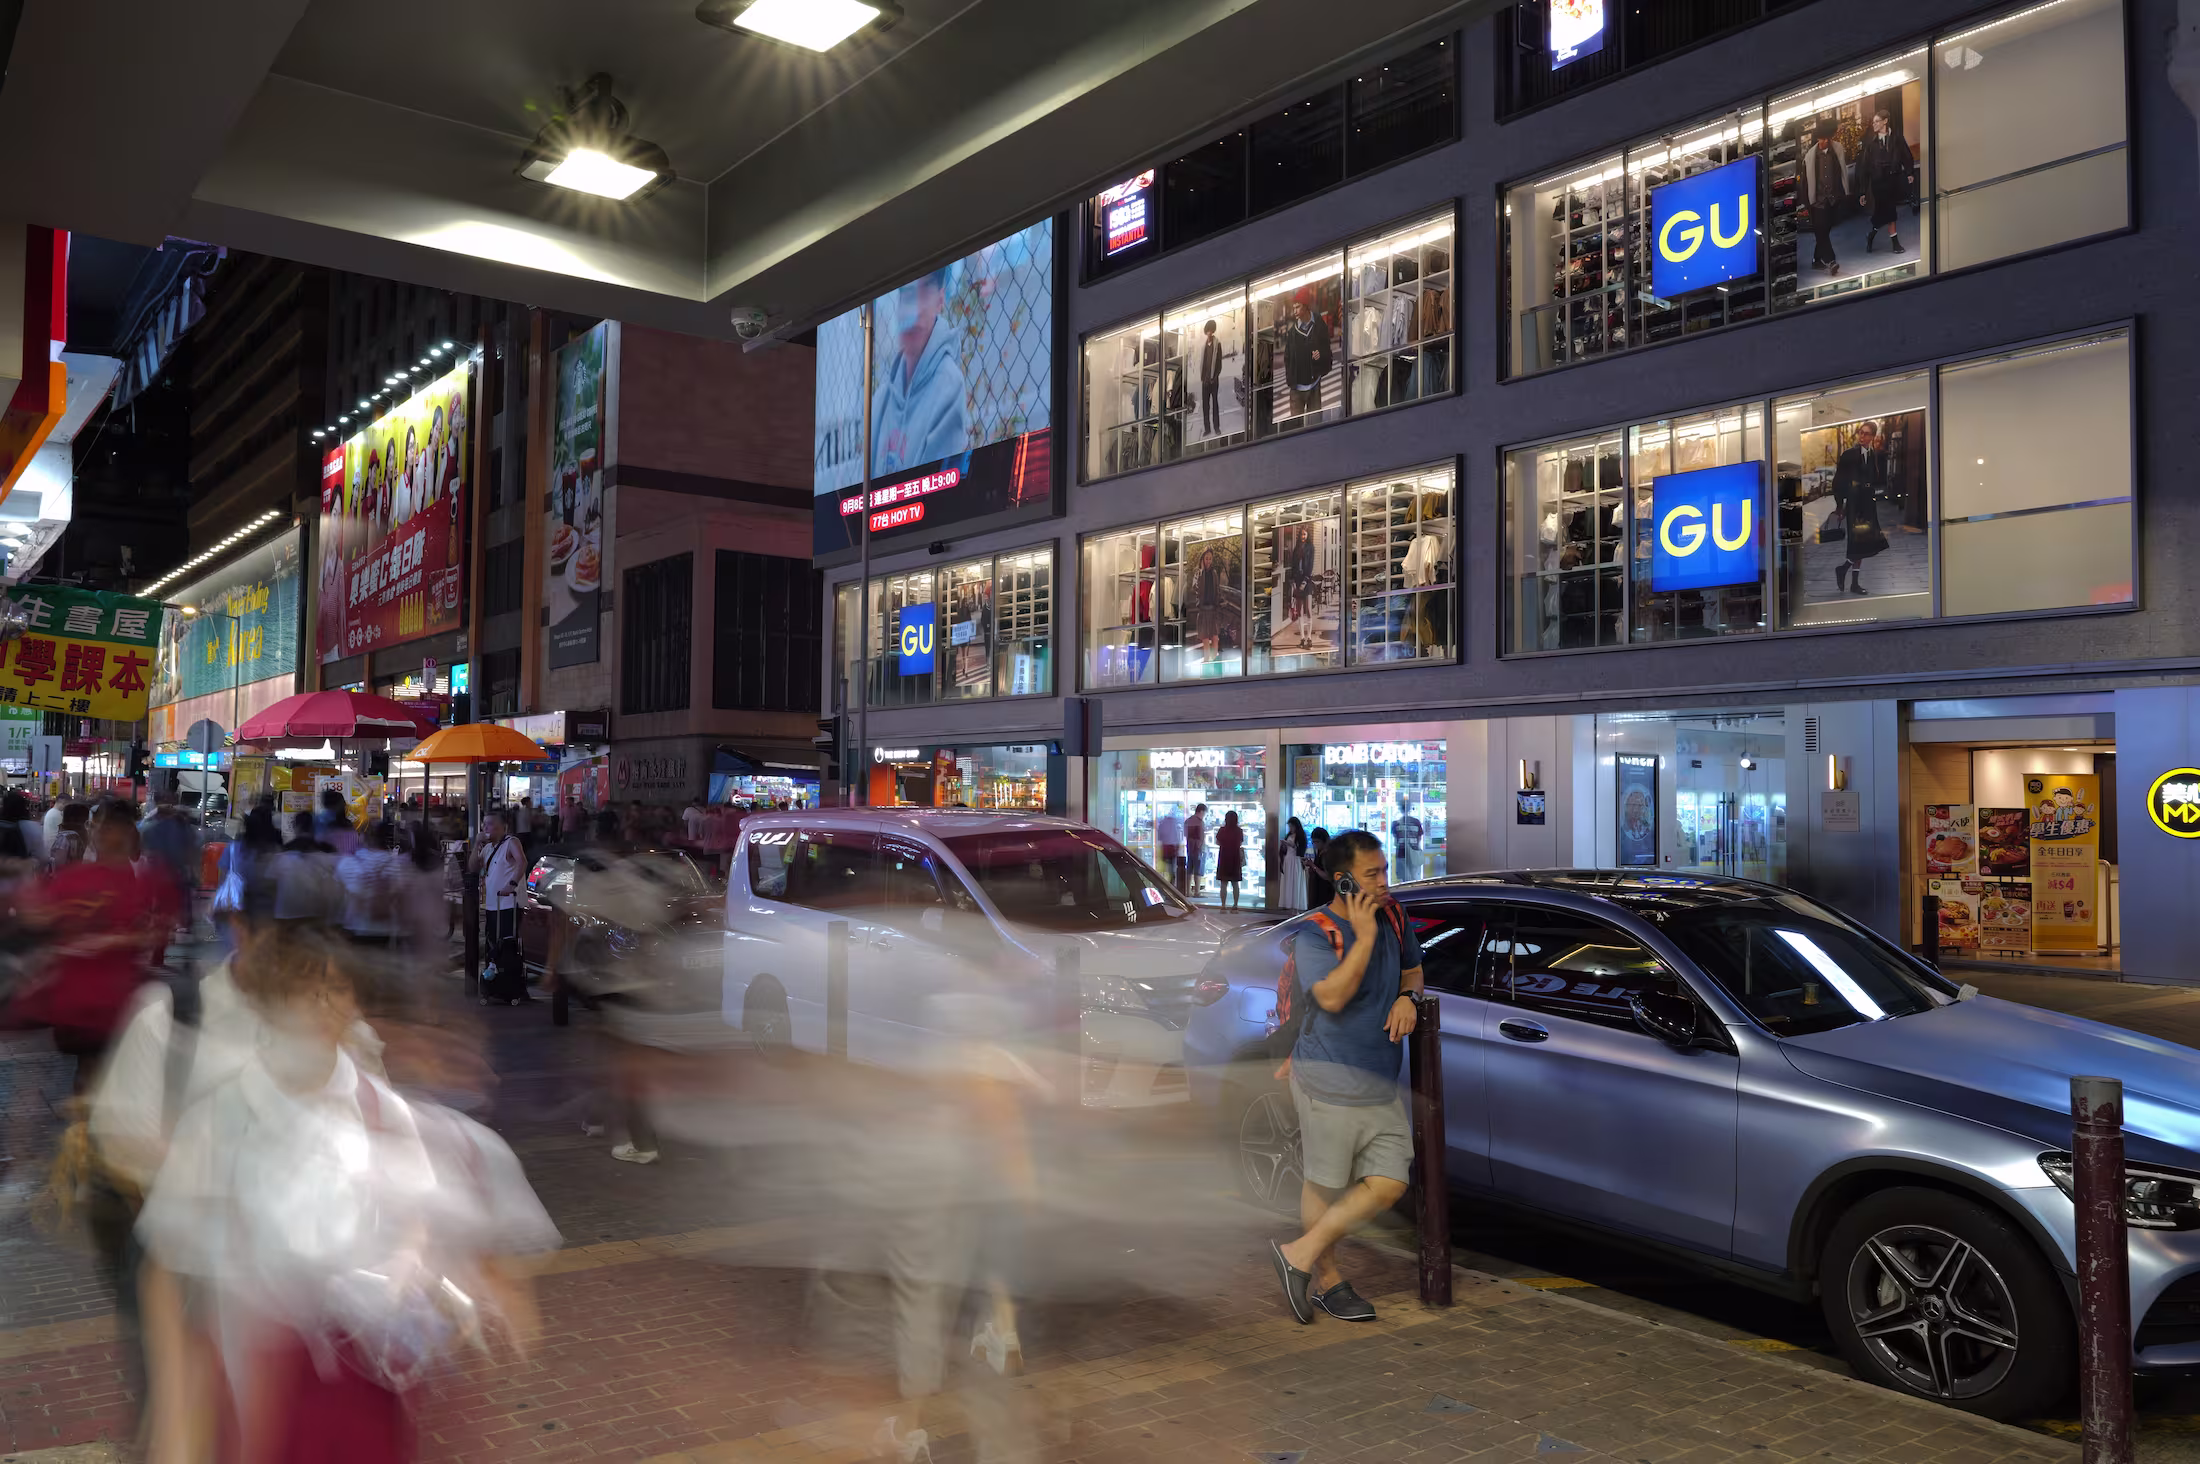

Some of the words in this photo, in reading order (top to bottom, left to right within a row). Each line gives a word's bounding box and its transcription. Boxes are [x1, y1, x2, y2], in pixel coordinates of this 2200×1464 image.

[1109, 225, 1145, 250] INSTANTLY
[1658, 193, 1749, 264] GU
[872, 513, 889, 528] 77台
[890, 509, 908, 524] HOY
[909, 505, 921, 518] TV
[1660, 498, 1752, 558] GU
[245, 580, 270, 614] Ending
[901, 623, 934, 657] GU
[0, 636, 149, 699] 學課本
[8, 727, 31, 739] 1/F
[2030, 819, 2090, 837] 學生優惠
[2038, 846, 2083, 857] 全年日日享
